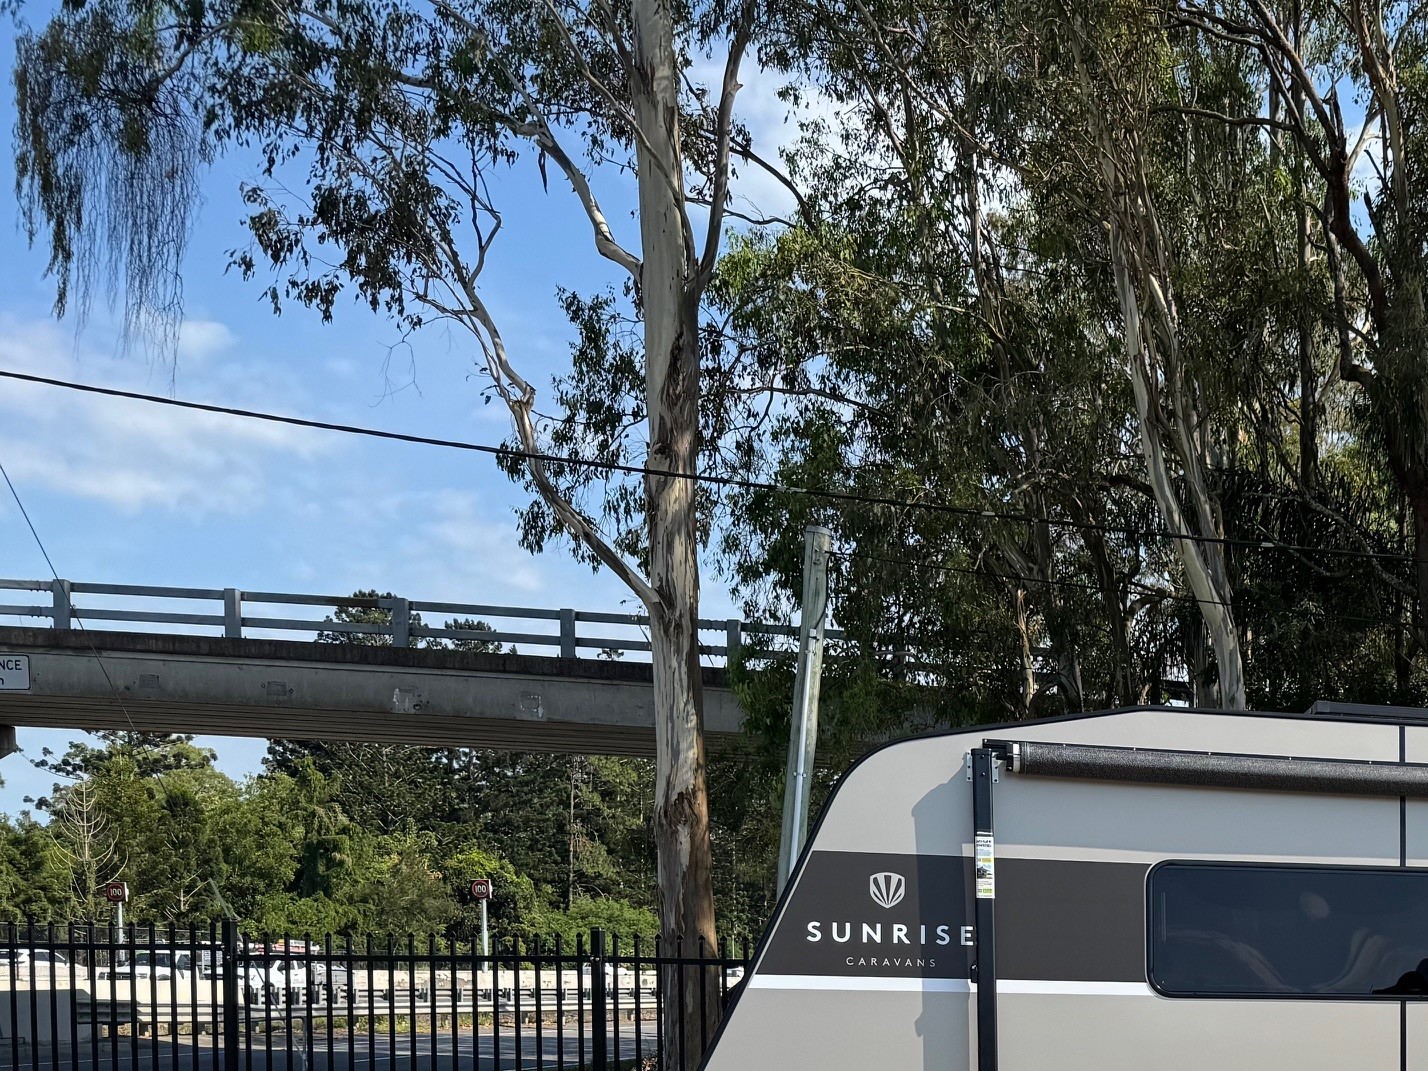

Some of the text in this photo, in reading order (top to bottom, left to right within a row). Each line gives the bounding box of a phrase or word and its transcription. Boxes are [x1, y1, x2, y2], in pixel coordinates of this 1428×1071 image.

[110, 888, 122, 896] 100
[475, 885, 486, 893] 100
[806, 920, 975, 946] SUNRISE
[845, 956, 937, 968] CARAVANS
